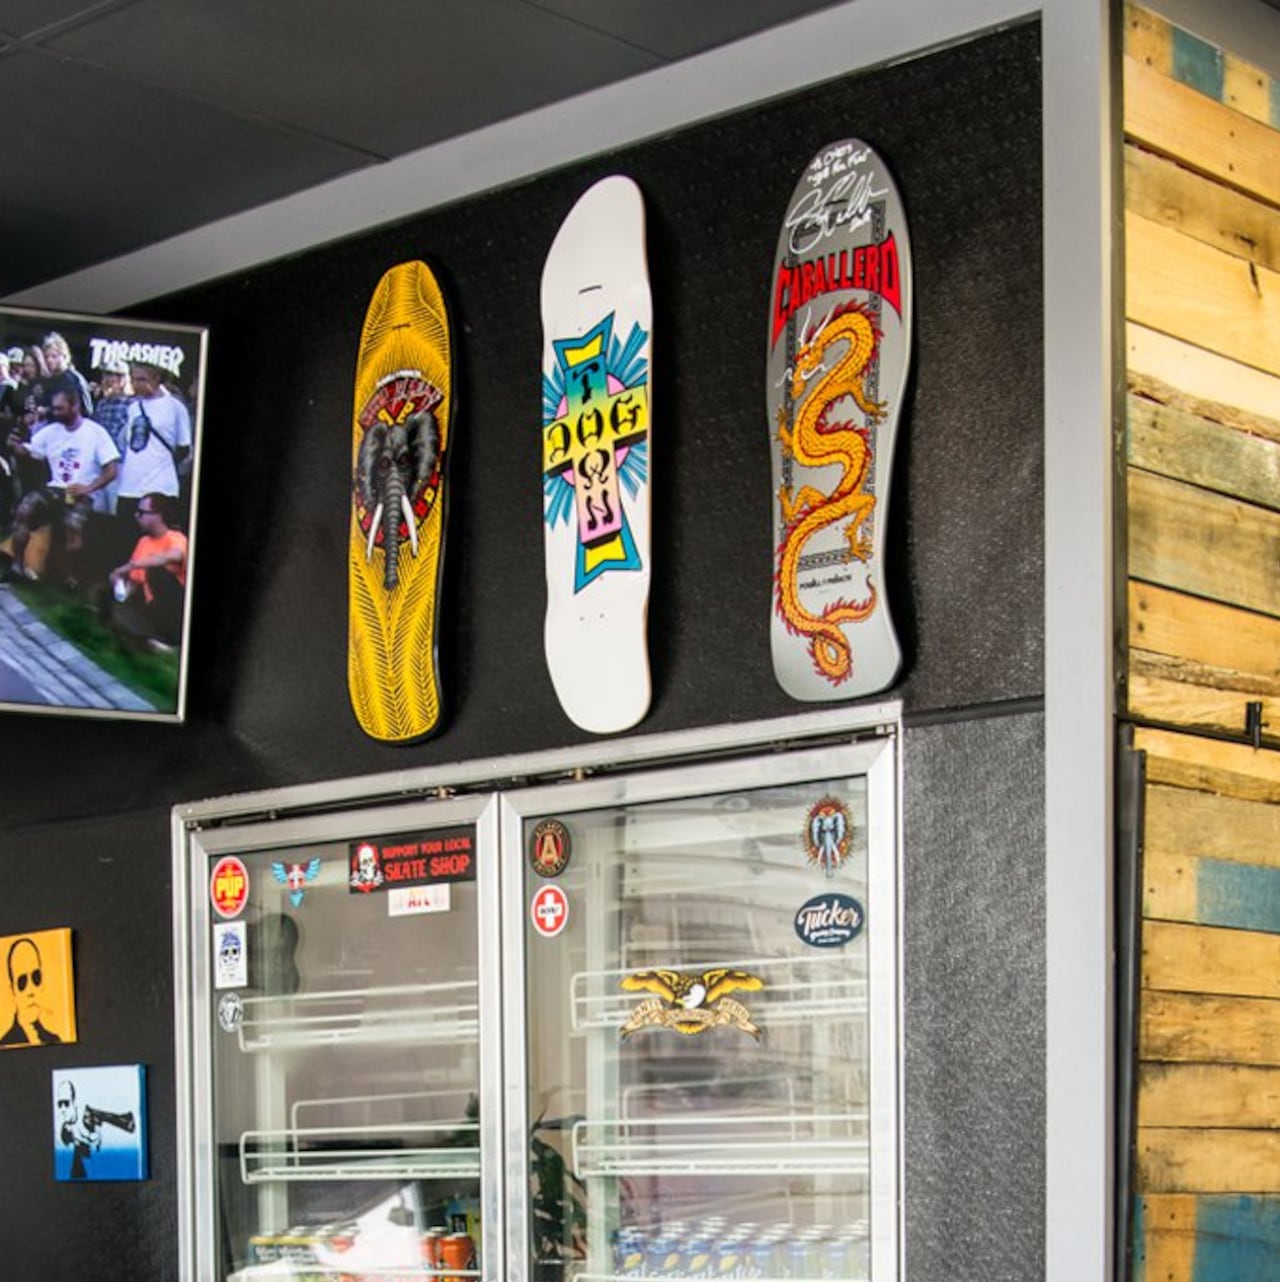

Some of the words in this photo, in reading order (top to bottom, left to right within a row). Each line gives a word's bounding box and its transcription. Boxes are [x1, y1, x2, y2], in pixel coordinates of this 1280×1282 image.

[771, 230, 903, 348] CABALLERO
[89, 338, 185, 378] THRASHER
[382, 844, 418, 859] SUPPORT
[421, 841, 442, 855] YOUR
[445, 838, 471, 852] LOCAL
[384, 859, 427, 882] SKATE
[430, 855, 470, 876] SHOP
[215, 876, 244, 901] PUP
[798, 900, 860, 937] Tucker
